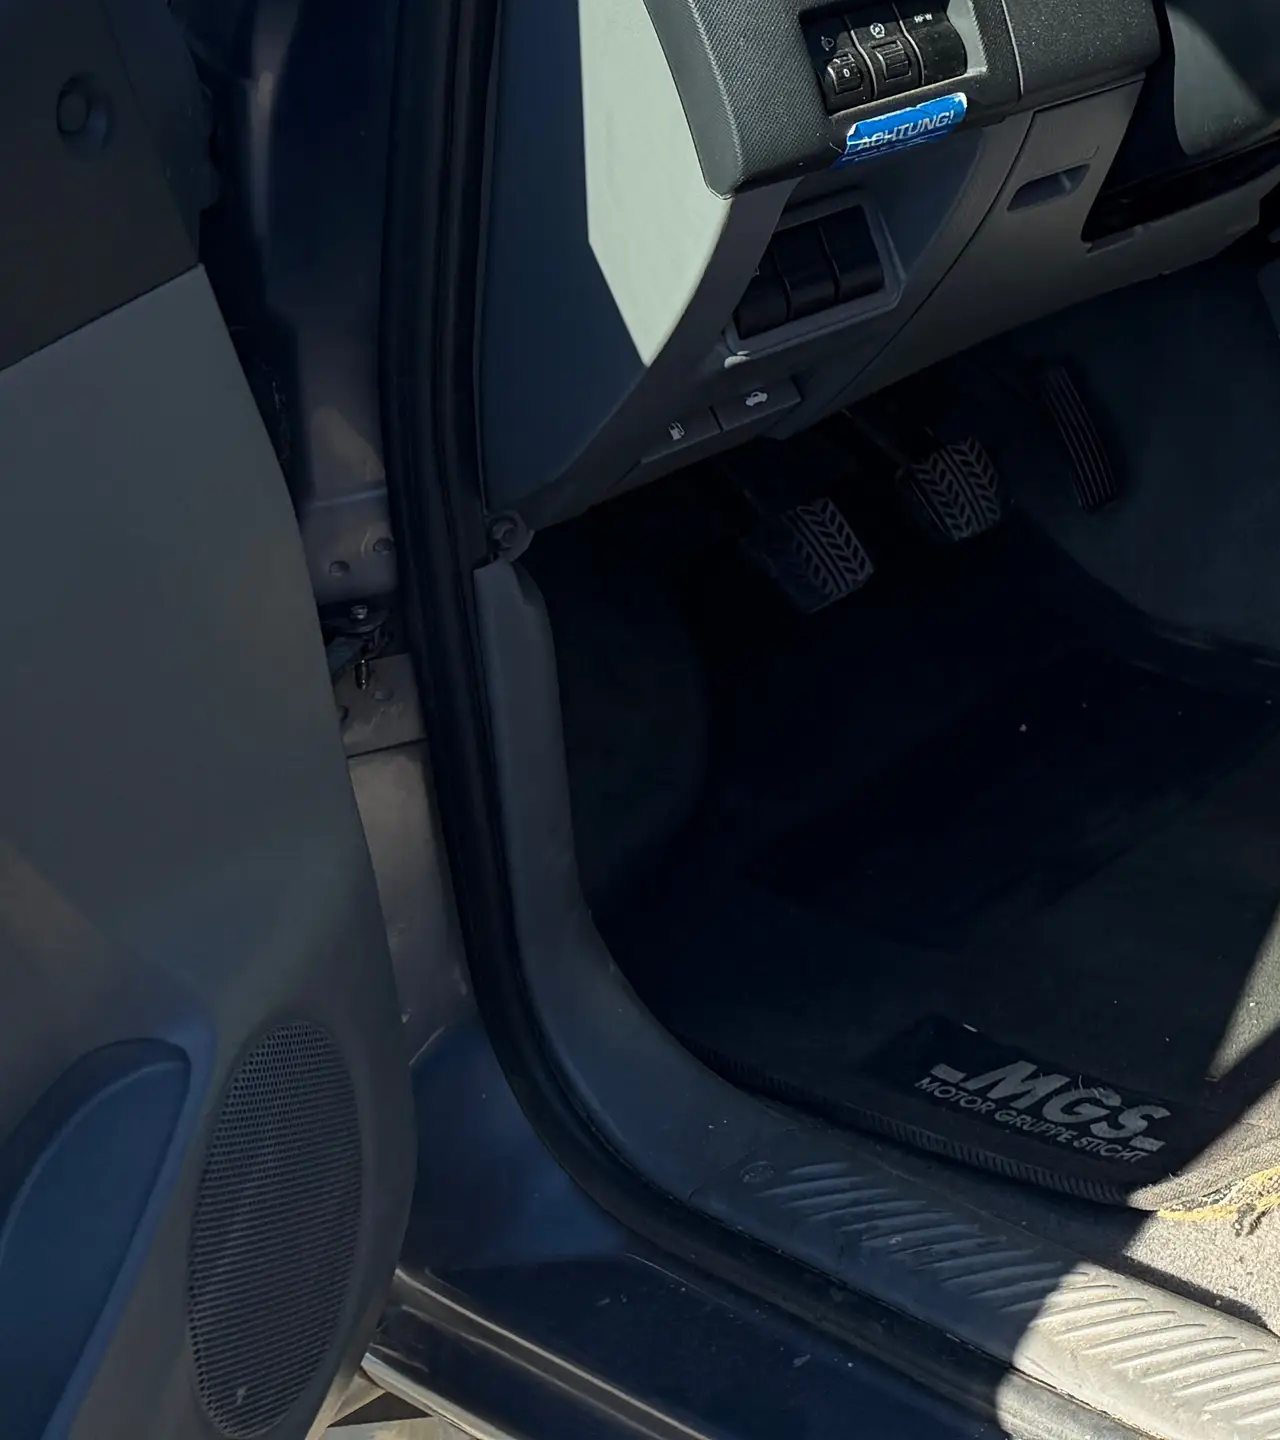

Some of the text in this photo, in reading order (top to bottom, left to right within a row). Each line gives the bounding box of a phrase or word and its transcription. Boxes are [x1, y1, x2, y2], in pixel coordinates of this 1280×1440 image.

[858, 110, 954, 148] ACHTUNG!
[914, 1076, 1150, 1163] MOTOR GRUPPE STICHT
[959, 1060, 1172, 1139] MGS
